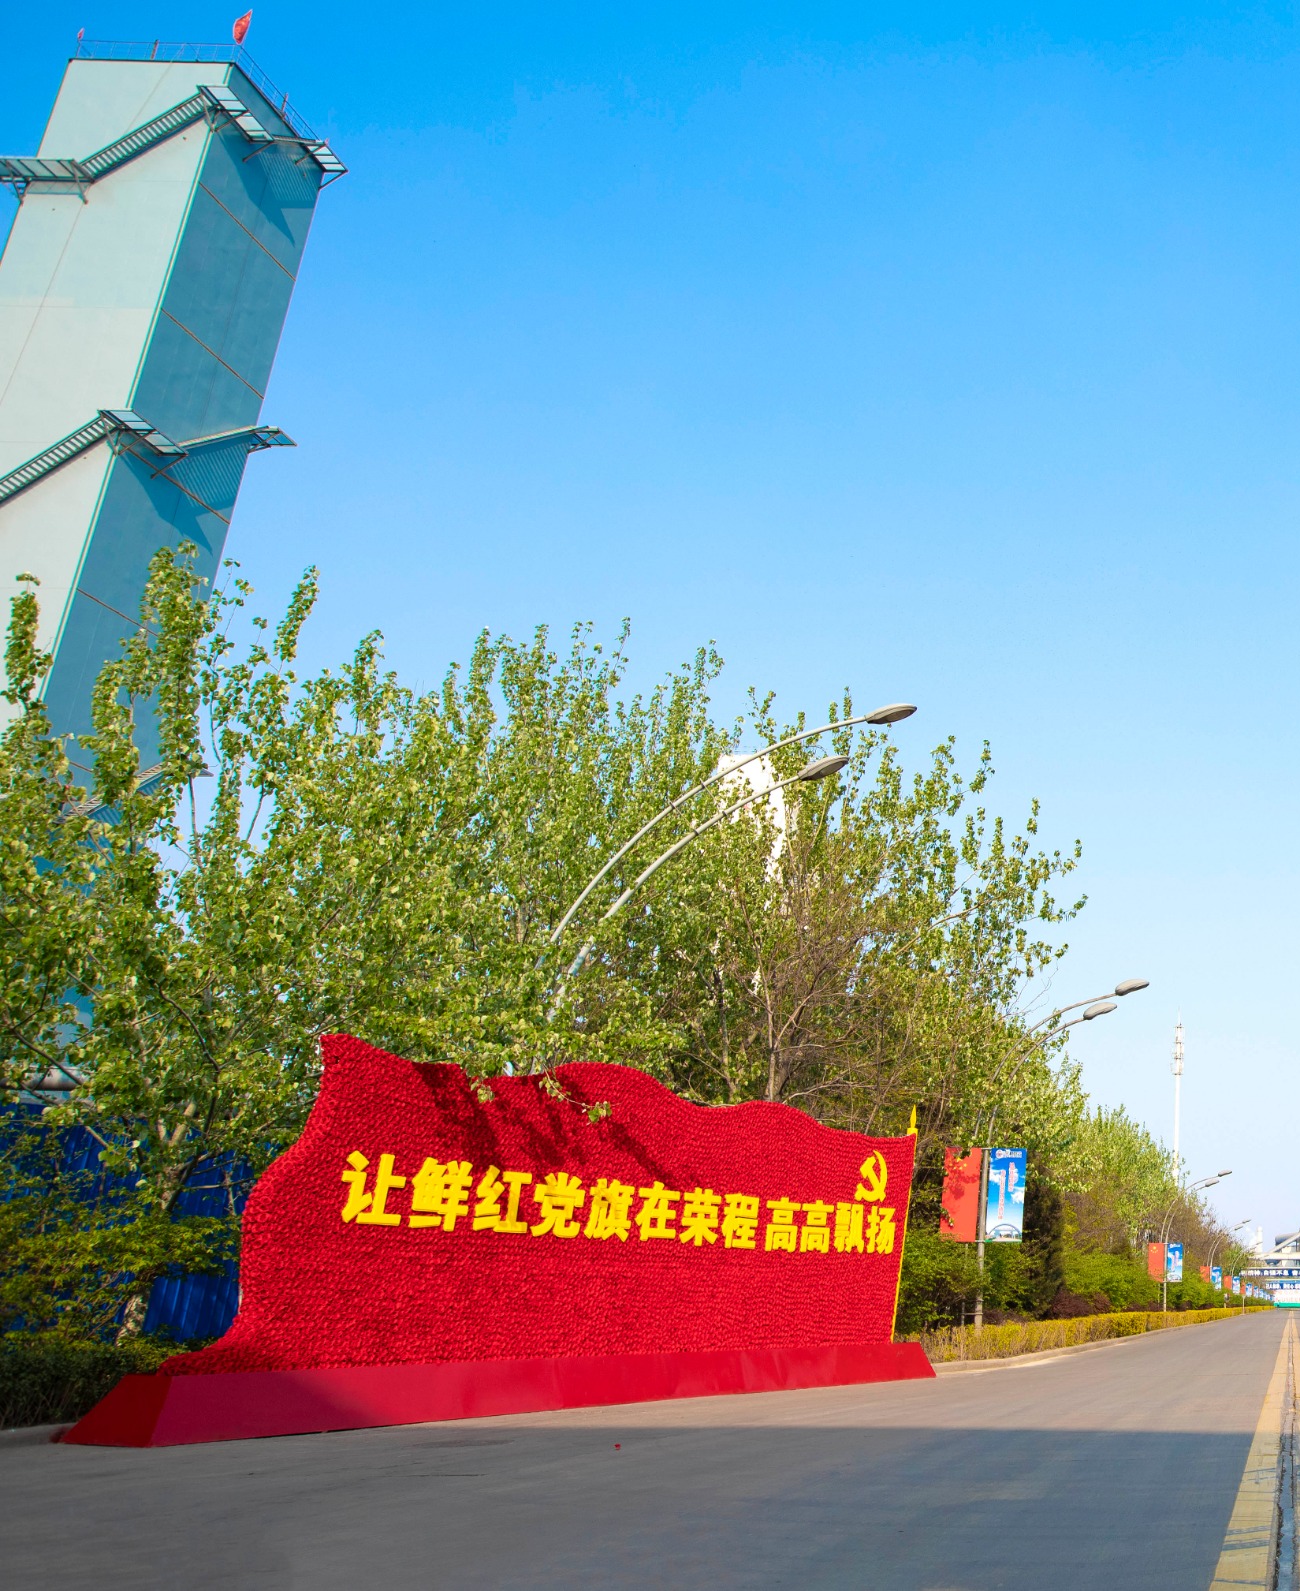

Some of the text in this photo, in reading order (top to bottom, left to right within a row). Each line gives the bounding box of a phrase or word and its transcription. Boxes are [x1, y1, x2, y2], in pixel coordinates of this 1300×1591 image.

[340, 1150, 897, 1255] 让鲜红党旗在荣程高高飘扬
